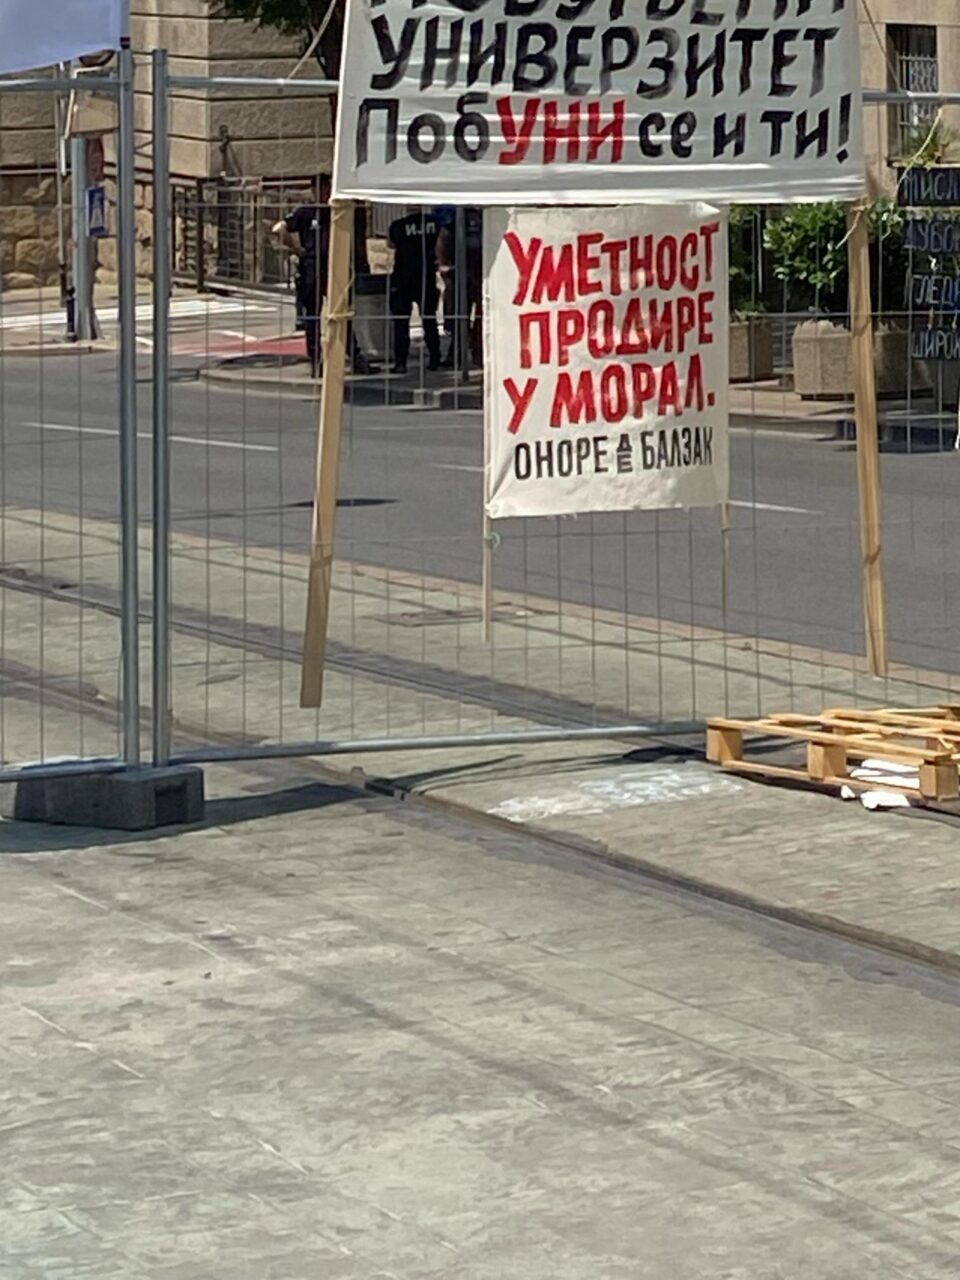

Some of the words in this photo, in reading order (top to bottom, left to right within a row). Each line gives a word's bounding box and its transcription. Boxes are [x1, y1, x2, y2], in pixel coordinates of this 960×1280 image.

[371, 15, 839, 99] УНИВЕРЗИТЕТ
[639, 109, 697, 159] се
[712, 109, 746, 158] и
[503, 222, 720, 306] УМЕТНОСТ
[519, 291, 715, 369] ПРОДИРЕ
[503, 377, 538, 435] У
[550, 353, 715, 428] МОРАЛ.
[514, 435, 609, 481] ОНОРЕ
[640, 426, 713, 471] БАЛЗАК
